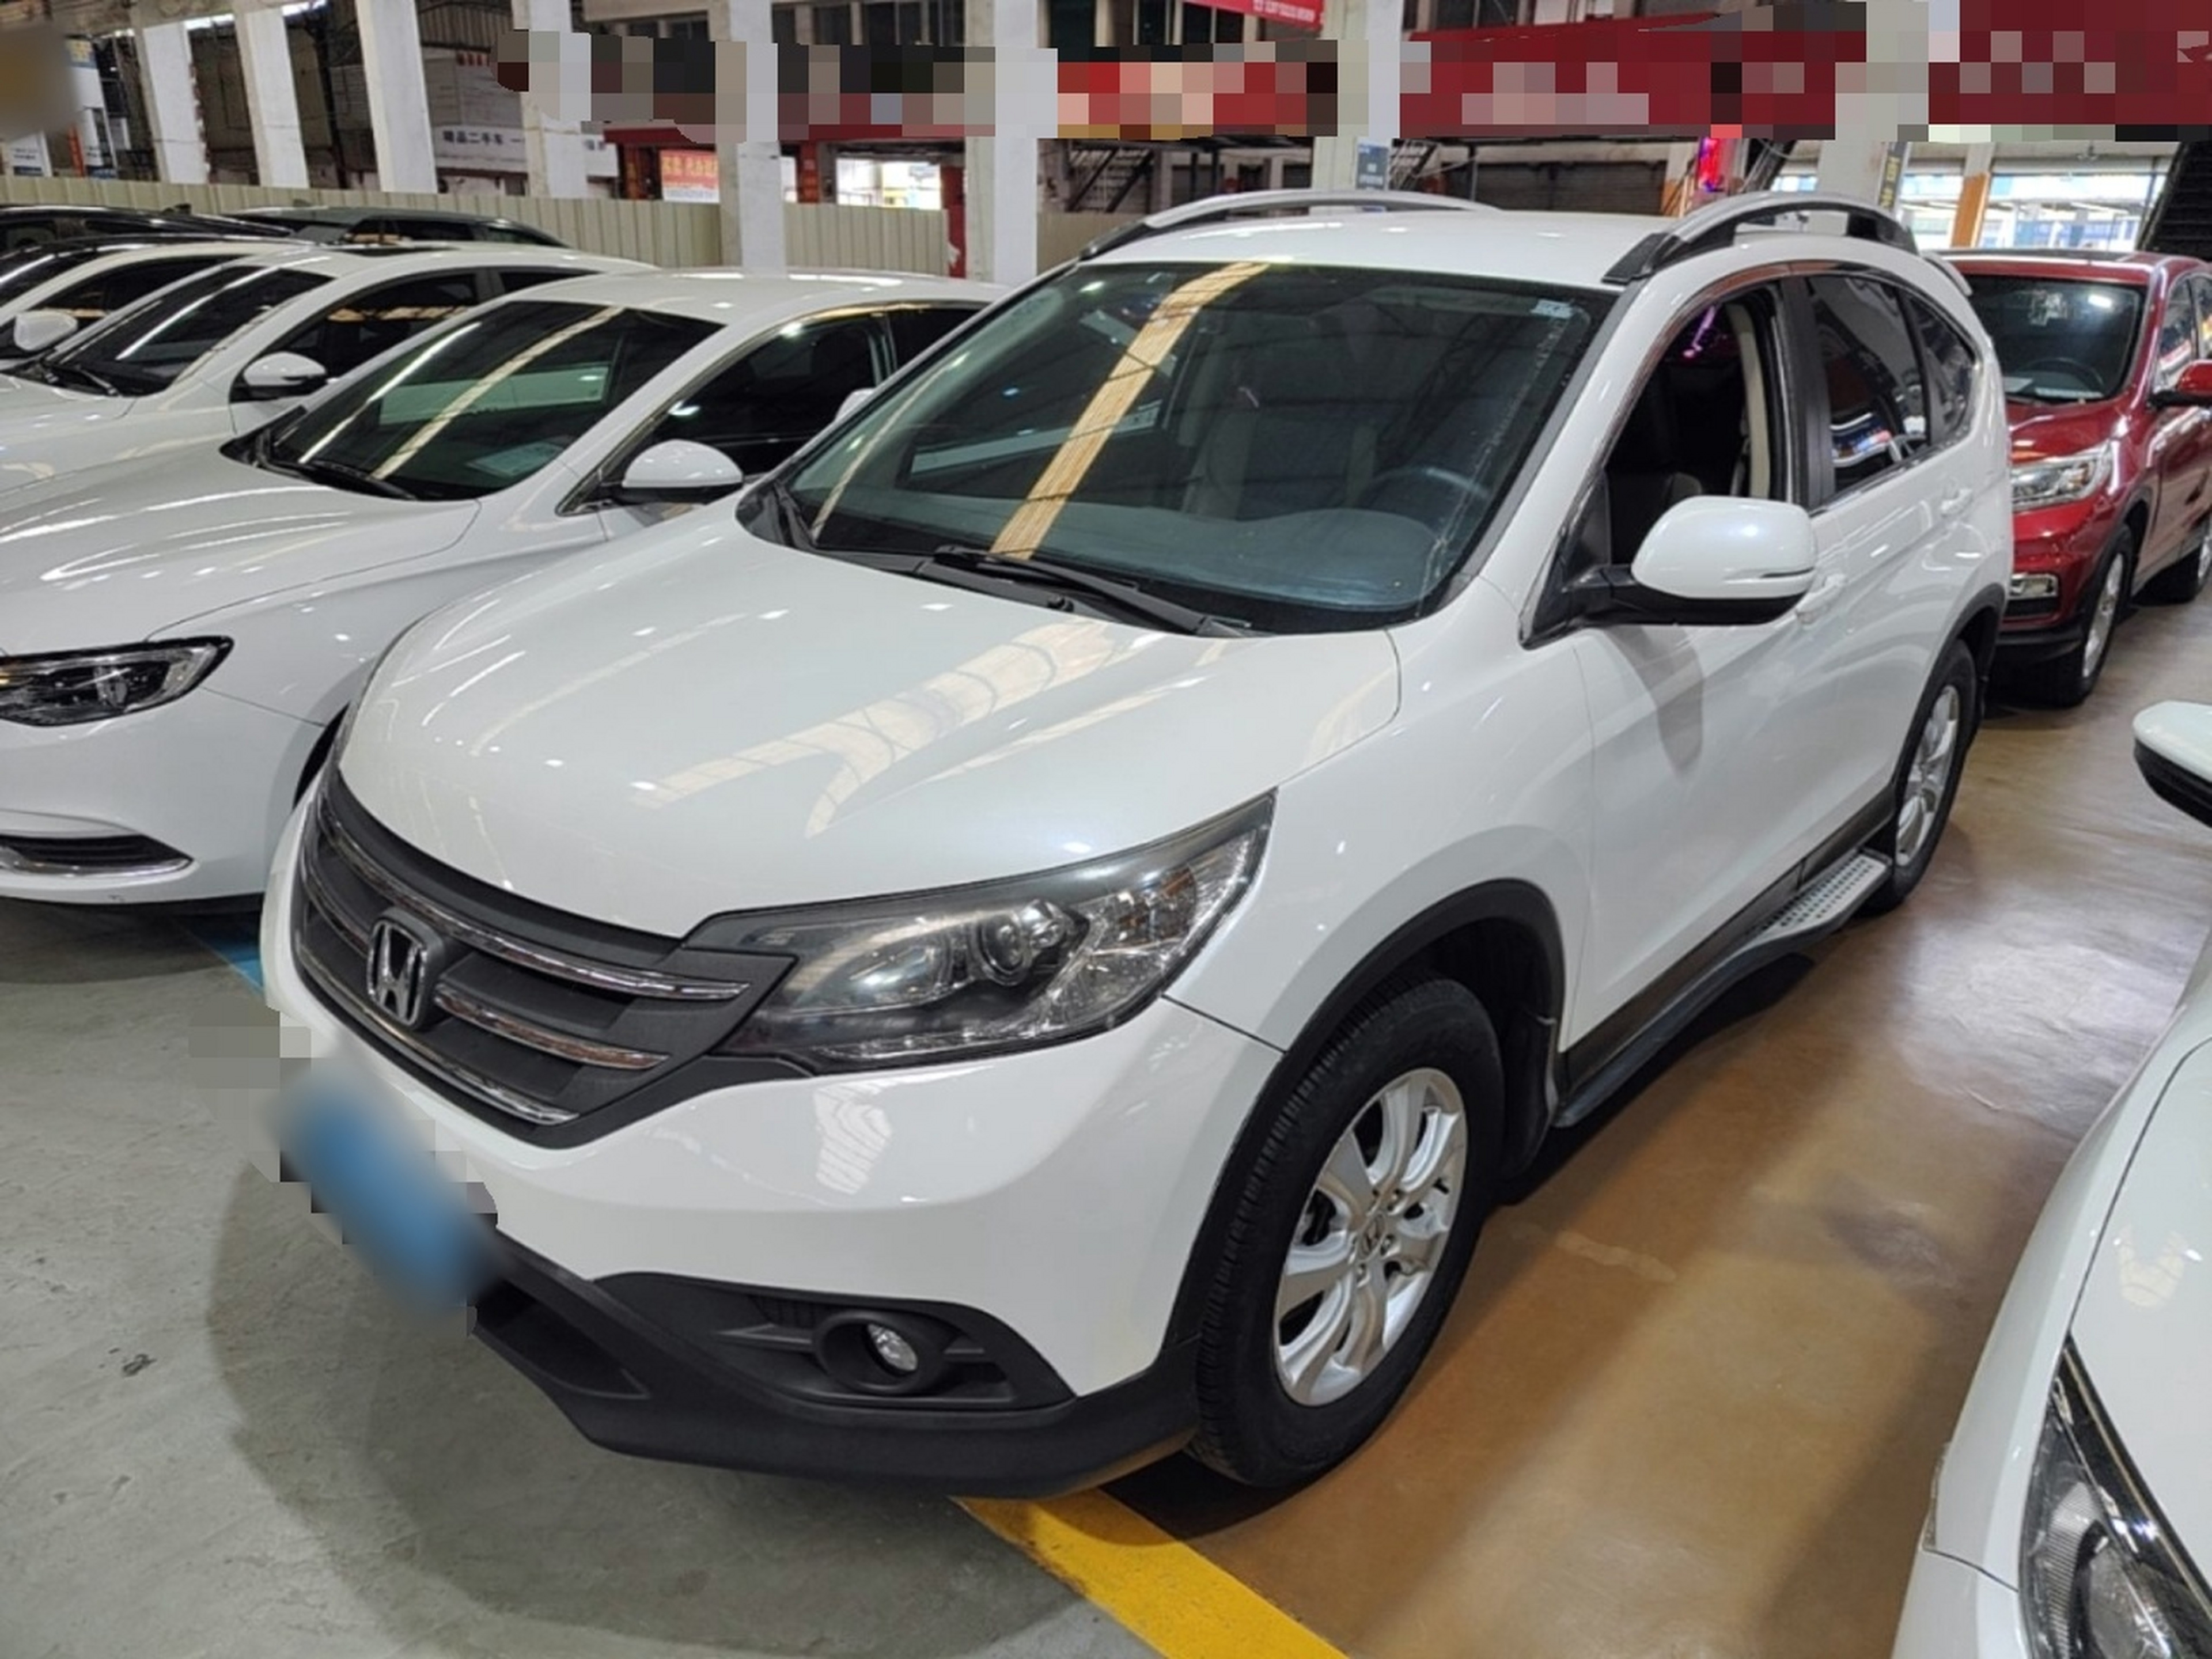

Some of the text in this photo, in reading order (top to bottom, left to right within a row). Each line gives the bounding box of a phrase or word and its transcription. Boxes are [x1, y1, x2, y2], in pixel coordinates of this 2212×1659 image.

[442, 130, 503, 145] 精品二手车
